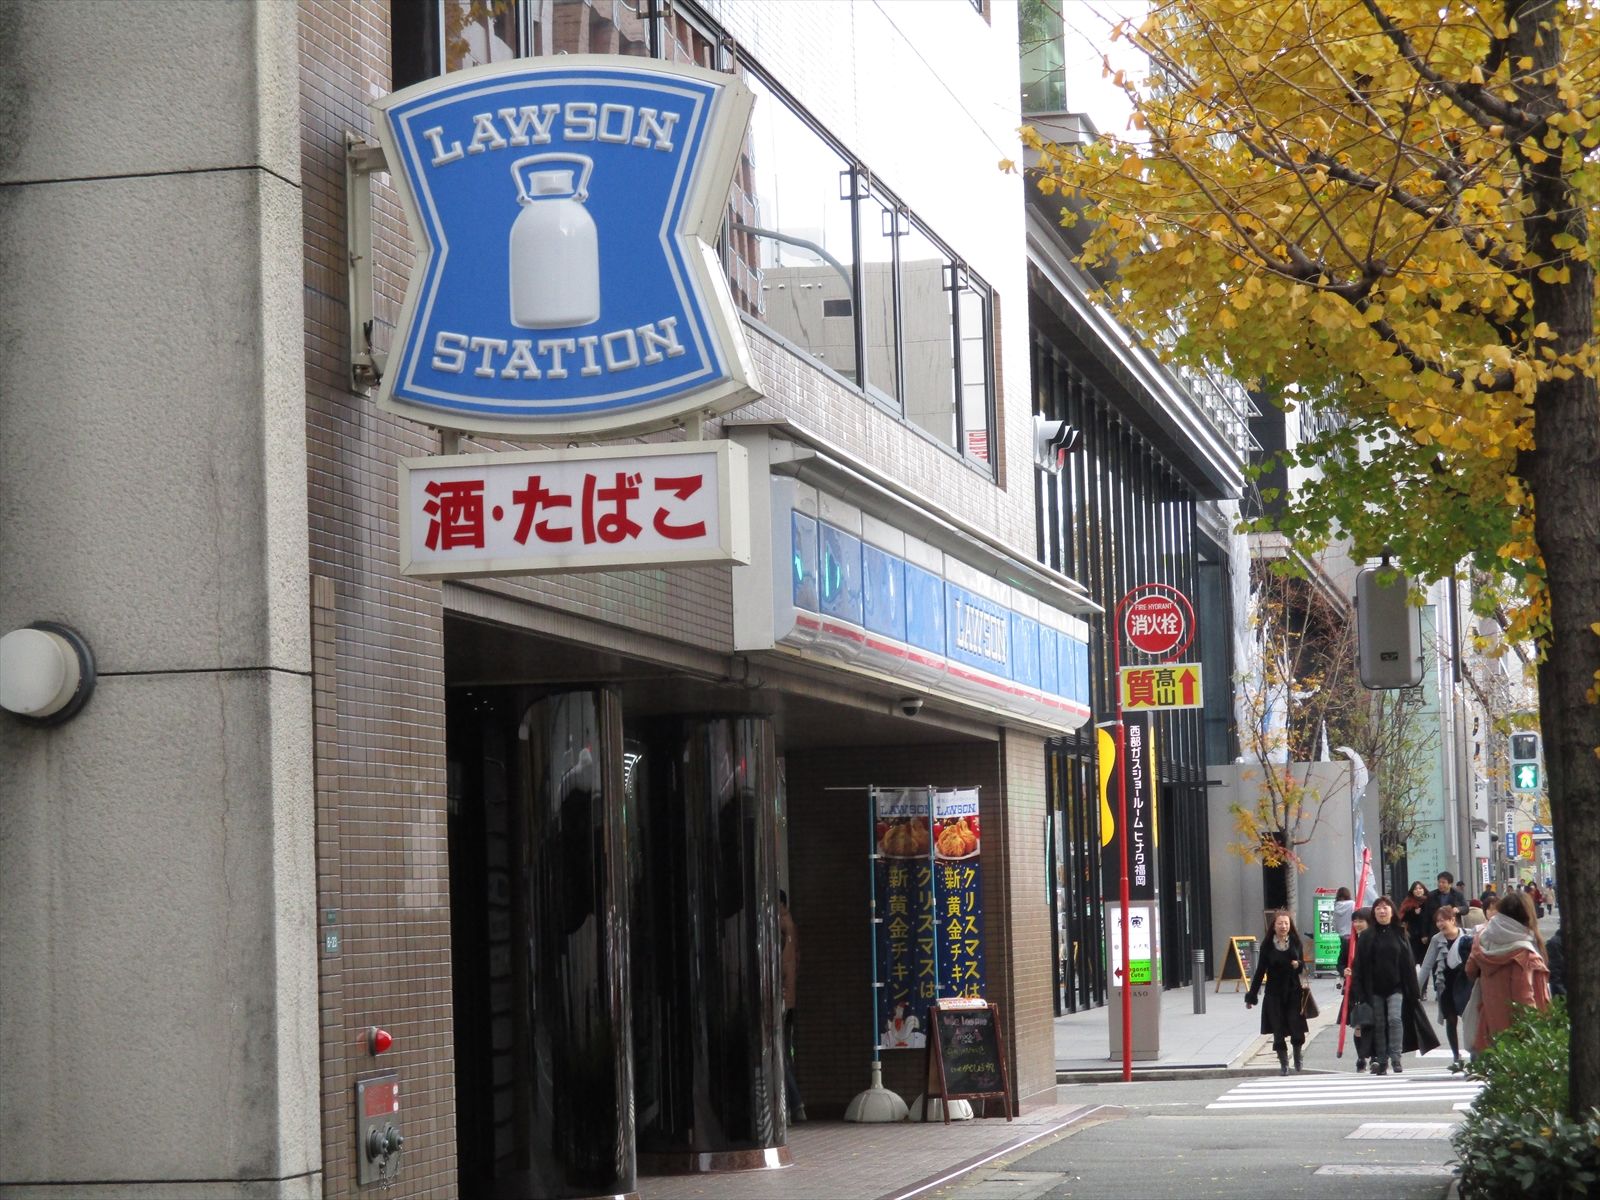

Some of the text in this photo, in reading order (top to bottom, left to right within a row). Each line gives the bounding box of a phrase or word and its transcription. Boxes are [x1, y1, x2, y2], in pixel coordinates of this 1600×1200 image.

[423, 102, 680, 168] LAWSON
[431, 316, 685, 380] STATION
[955, 598, 1007, 666] LAWSON
[1131, 612, 1178, 636] 消火栓
[1147, 603, 1173, 611] HYDRANT
[1126, 669, 1157, 707] 質
[1155, 668, 1176, 706] 高山
[936, 803, 977, 816] LAWSON
[916, 867, 935, 999] クリスマスは
[963, 868, 981, 998] クリスマスは
